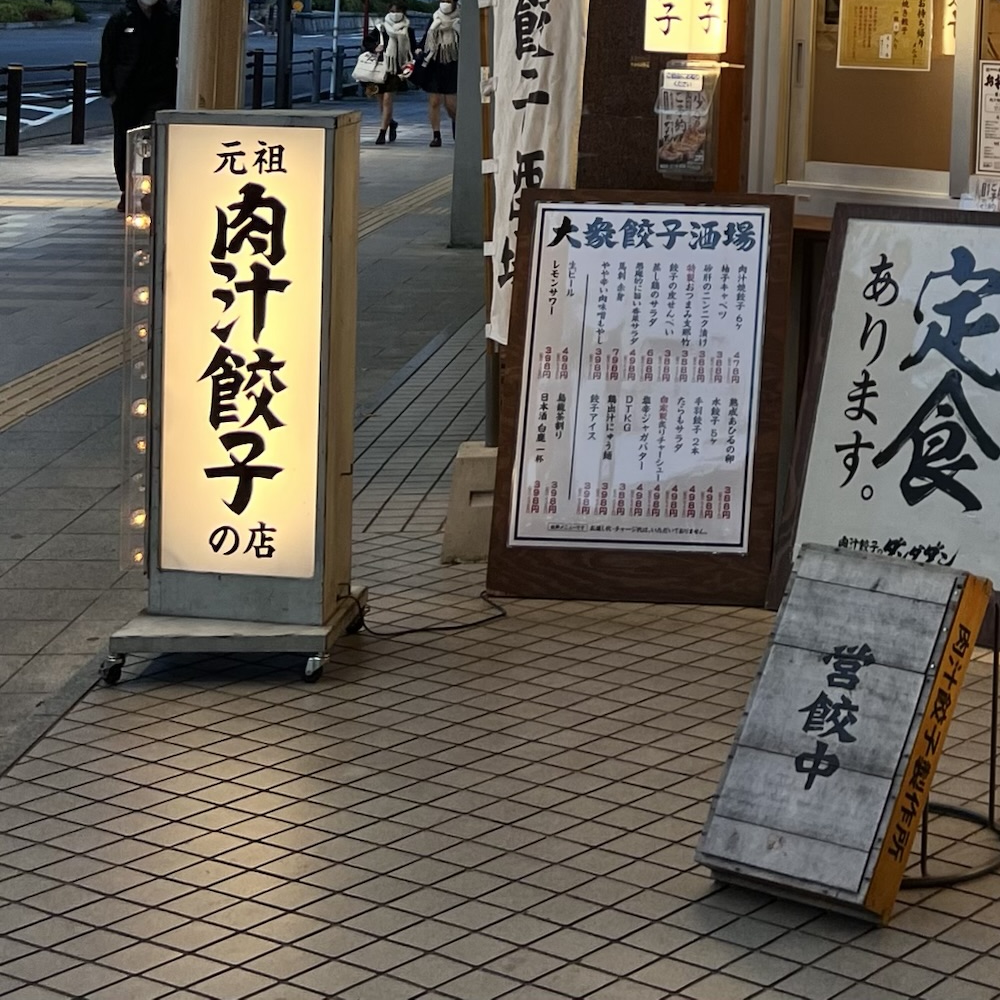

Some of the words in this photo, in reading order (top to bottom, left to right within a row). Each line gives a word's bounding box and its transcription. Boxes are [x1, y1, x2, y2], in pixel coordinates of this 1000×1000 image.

[214, 140, 288, 175] 元祖
[547, 215, 757, 252] 大衆餃子酒場
[548, 260, 560, 316] レモンサワー
[665, 262, 679, 336] 餃子の皮せんべい
[717, 264, 730, 319] 柚子キャベツ
[196, 182, 292, 516] 肉汁餃子
[834, 252, 900, 501] あります。
[538, 392, 549, 421] 日本酒
[588, 394, 600, 441] 餃子アイス
[623, 395, 633, 433] DTKG
[692, 396, 703, 434] 手羽餃子
[710, 397, 721, 426] 水餃子
[634, 483, 643, 517] 498円
[651, 484, 661, 517] 498円
[669, 484, 678, 518] 498円
[687, 485, 696, 518] 498円
[704, 486, 713, 519] 498円
[208, 521, 277, 559] の店
[794, 643, 877, 791] 営餃中
[886, 622, 972, 864] 肉汁餃子製作所
